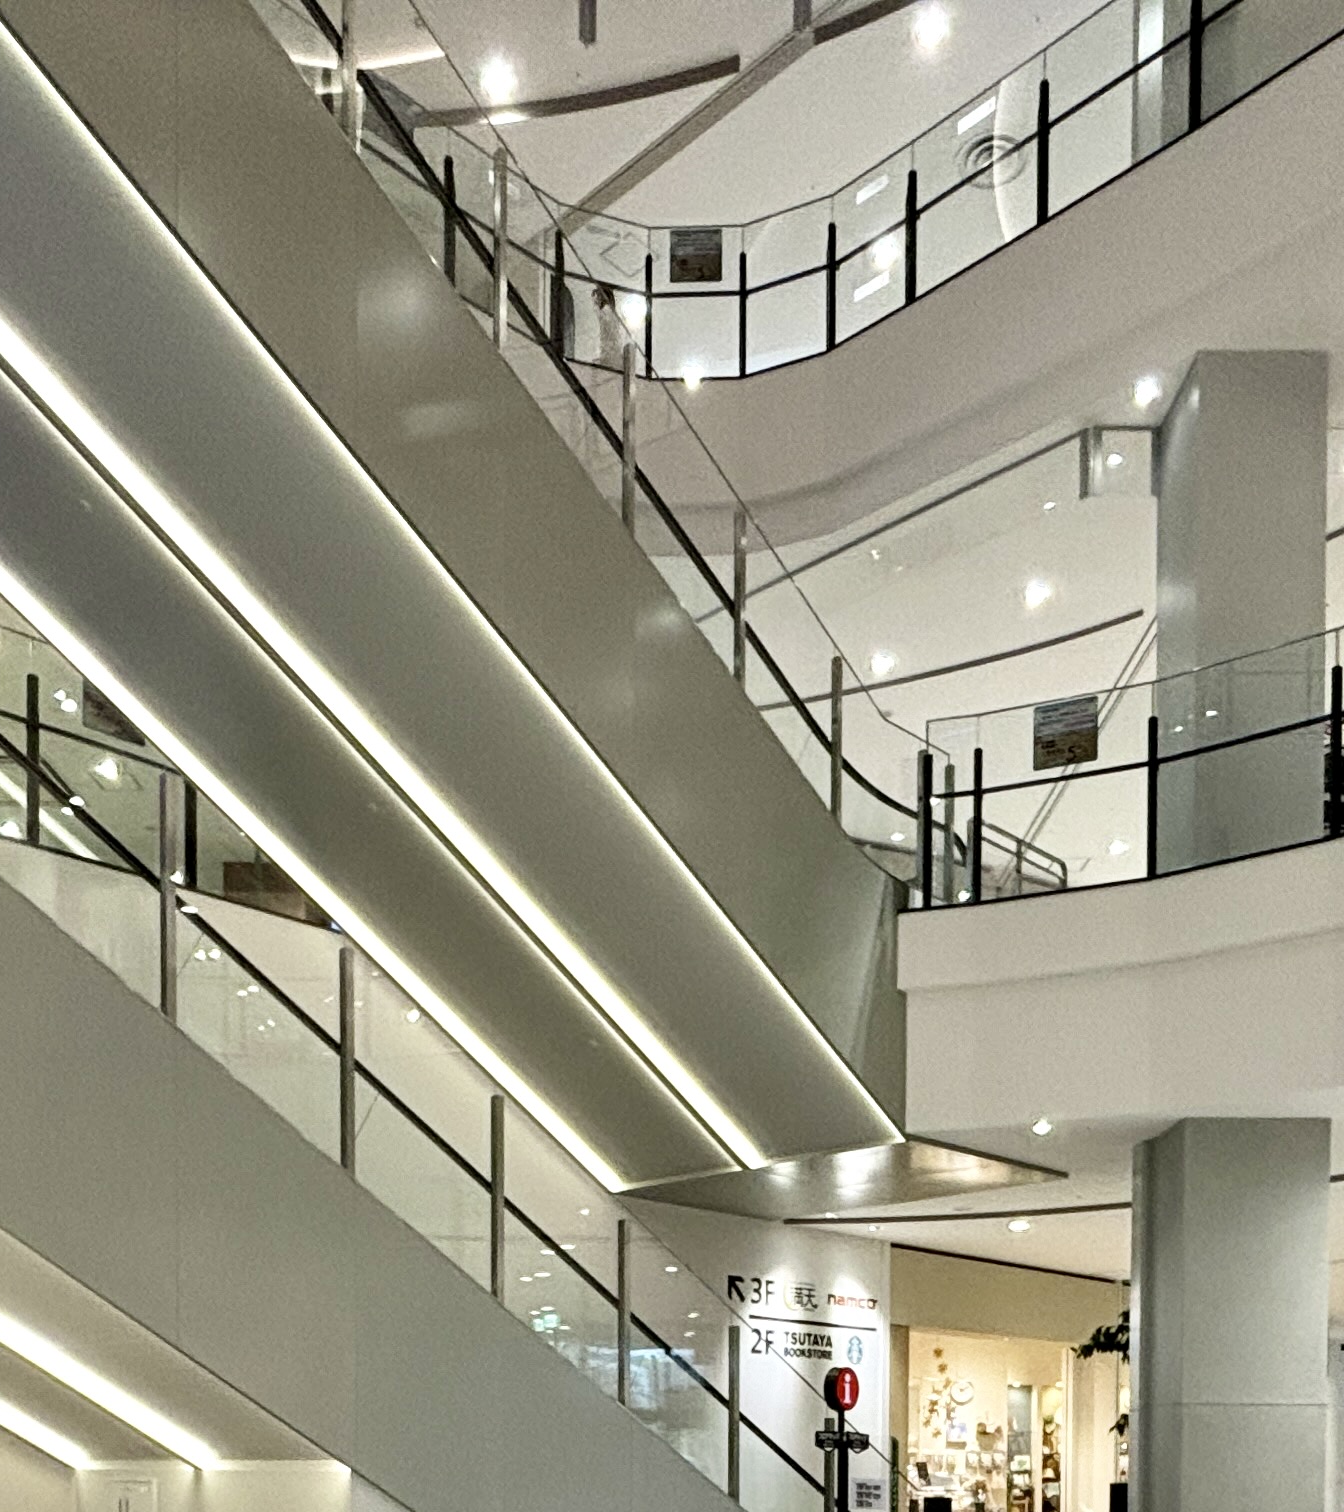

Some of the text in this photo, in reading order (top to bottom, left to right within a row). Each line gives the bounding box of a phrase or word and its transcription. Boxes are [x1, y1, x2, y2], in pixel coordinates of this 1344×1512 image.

[750, 1277, 776, 1305] 3F
[827, 1293, 878, 1310] namco
[751, 1328, 775, 1355] 2F
[783, 1331, 833, 1348] TSUTAYA
[783, 1347, 833, 1360] BOOKSTORE
